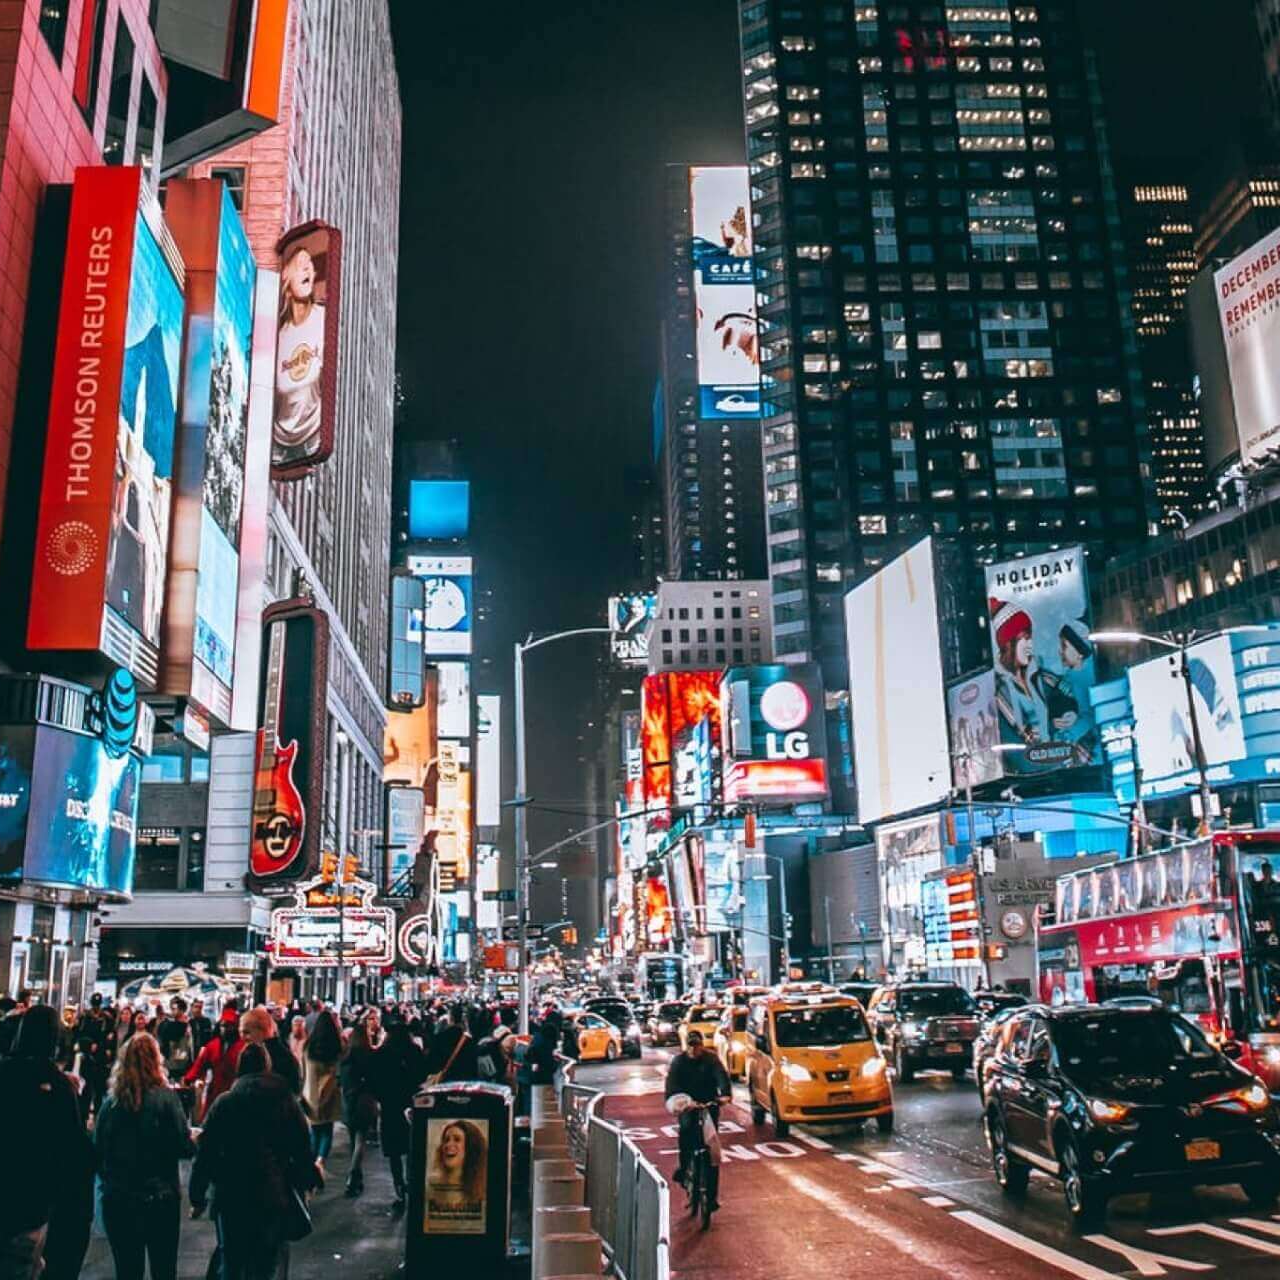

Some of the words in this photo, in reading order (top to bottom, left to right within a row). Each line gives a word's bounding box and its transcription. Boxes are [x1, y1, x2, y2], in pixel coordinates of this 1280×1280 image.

[81, 226, 113, 350] REUTERS
[67, 356, 101, 502] THOMSON
[996, 558, 1074, 586] HOLIDAY
[765, 731, 809, 760] LG
